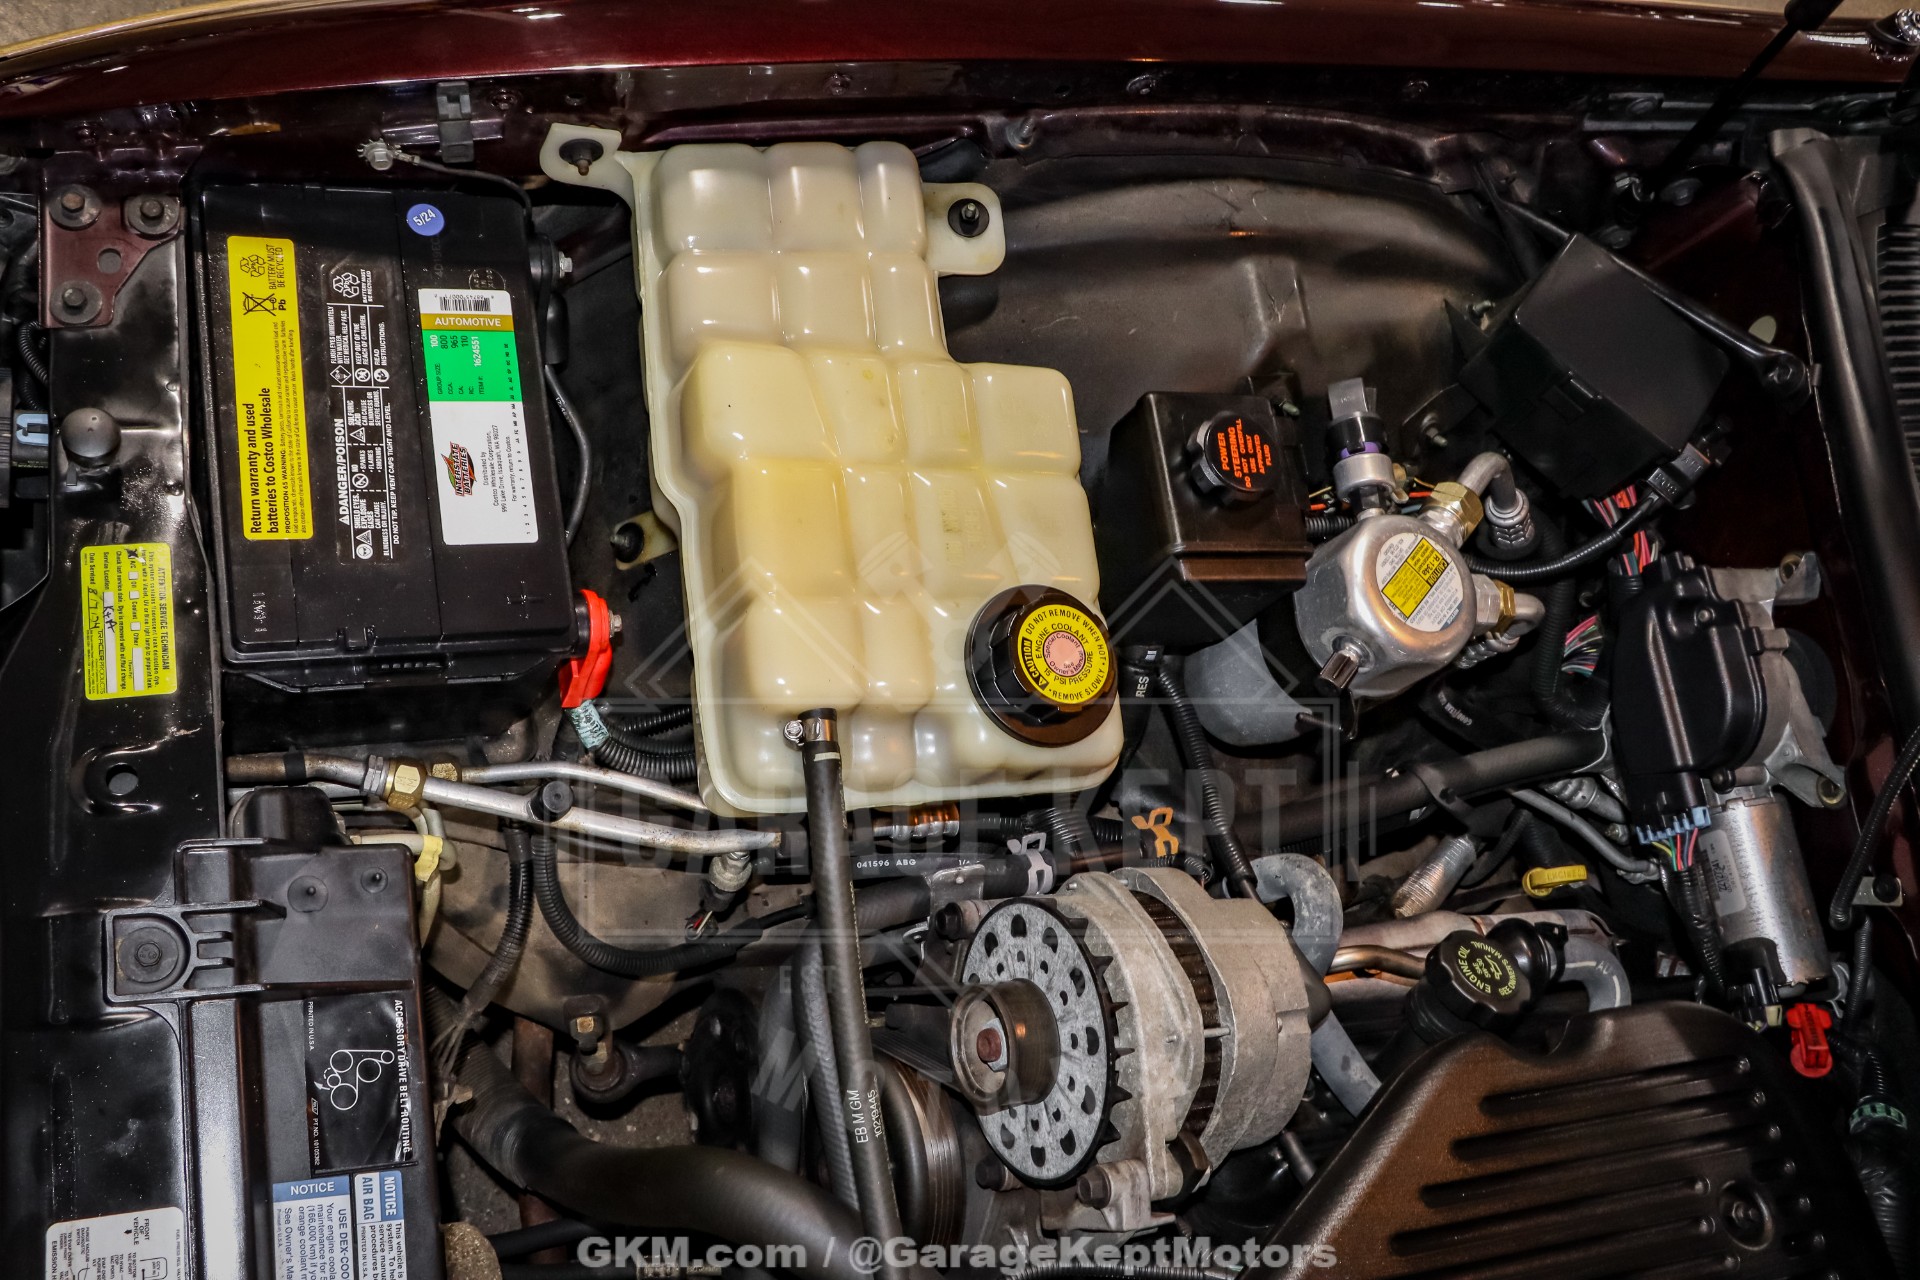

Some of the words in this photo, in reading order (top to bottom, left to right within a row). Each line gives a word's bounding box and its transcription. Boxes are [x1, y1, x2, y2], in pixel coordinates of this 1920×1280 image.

[412, 208, 436, 225] 5/24
[266, 243, 275, 261] MUST
[267, 263, 276, 289] BATTERY
[277, 298, 286, 311] Pb
[434, 314, 501, 328] AUTOMOTIVE
[378, 321, 387, 365] INSTRUCTIONS.
[429, 333, 439, 347] 100
[439, 334, 448, 349] 800
[449, 334, 458, 348] 965
[460, 335, 468, 347] 110
[471, 335, 482, 367] 1624551
[435, 376, 443, 394] GROUP
[242, 402, 255, 427] used
[257, 387, 273, 439] Wholesale
[346, 399, 355, 425] SULFURIC
[243, 428, 256, 448] and
[1235, 418, 1245, 453] OVERFILL
[1245, 434, 1253, 453] ONLY
[262, 441, 275, 473] Costco
[280, 447, 288, 480] WARNING:
[1217, 432, 1229, 470] POWER
[1227, 426, 1242, 477] STEERING
[1254, 434, 1265, 473] APPROVED
[1263, 444, 1271, 465] FLUID
[246, 449, 263, 496] warranty
[333, 417, 349, 514] DANGER/POISON
[351, 464, 358, 472] NO
[451, 443, 462, 495] INTERSTATE
[458, 446, 471, 493] BATTERIES
[264, 475, 276, 486] to
[282, 481, 288, 489] 65
[1244, 476, 1251, 487] DO
[248, 498, 262, 533] Return
[263, 488, 279, 533] batteries
[282, 490, 291, 533] PROPOSITION
[353, 509, 361, 528] SHIELD
[359, 498, 368, 528] EXPLOSIVE
[393, 534, 399, 544] DO
[1420, 553, 1441, 577] R-134a
[1425, 558, 1448, 585] CAUTION
[159, 602, 167, 629] SERVICE
[1025, 622, 1035, 634] DO
[1032, 611, 1047, 624] NOT
[1048, 608, 1080, 621] REMOVE
[1082, 619, 1100, 641] WHEN
[1097, 644, 1106, 664] HOT
[1035, 627, 1049, 658] ENGINE
[1051, 623, 1088, 644] COOLANT
[1044, 635, 1056, 658] Special
[1056, 632, 1080, 648] Coolant
[160, 631, 169, 670] TECHNICIAN
[1023, 640, 1039, 677] CAUTION
[1049, 660, 1073, 674] Owner's
[1073, 650, 1084, 671] Manual
[1043, 667, 1051, 676] 15
[1053, 676, 1066, 685] PSI
[1068, 650, 1093, 684] PRESSURE
[1052, 690, 1083, 700] REMOVE
[1084, 668, 1105, 695] SLOWLY
[1135, 675, 1149, 698] RES
[856, 859, 890, 868] 041596
[895, 858, 916, 866] ABG
[1457, 945, 1470, 958] OIL
[1470, 941, 1502, 958] MANUAL
[1458, 958, 1491, 993] ENGINE
[392, 999, 406, 1052] ACCESSORY
[396, 1054, 408, 1083] DRIVE
[398, 1085, 409, 1109] BELT
[846, 1089, 861, 1109] GM
[851, 1112, 864, 1123] M
[867, 1089, 882, 1137] 10219445
[399, 1110, 412, 1153] ROUTING
[854, 1126, 868, 1142] EB
[290, 1182, 335, 1195] NOTICE
[362, 1177, 373, 1195] AIR
[384, 1177, 397, 1216] NOTICE
[326, 1203, 334, 1222] Your
[338, 1209, 348, 1228] USE
[364, 1198, 374, 1220] BAG
[139, 1226, 144, 1235] OF
[326, 1223, 335, 1254] engine
[386, 1224, 394, 1255] system.
[285, 1226, 293, 1264] Owner's
[299, 1239, 307, 1271] coolant
[308, 1244, 317, 1260] km)
[369, 1225, 378, 1271] procedures
[395, 1244, 403, 1268] vehicle
[319, 1261, 327, 1271] for
[389, 1257, 395, 1267] To
